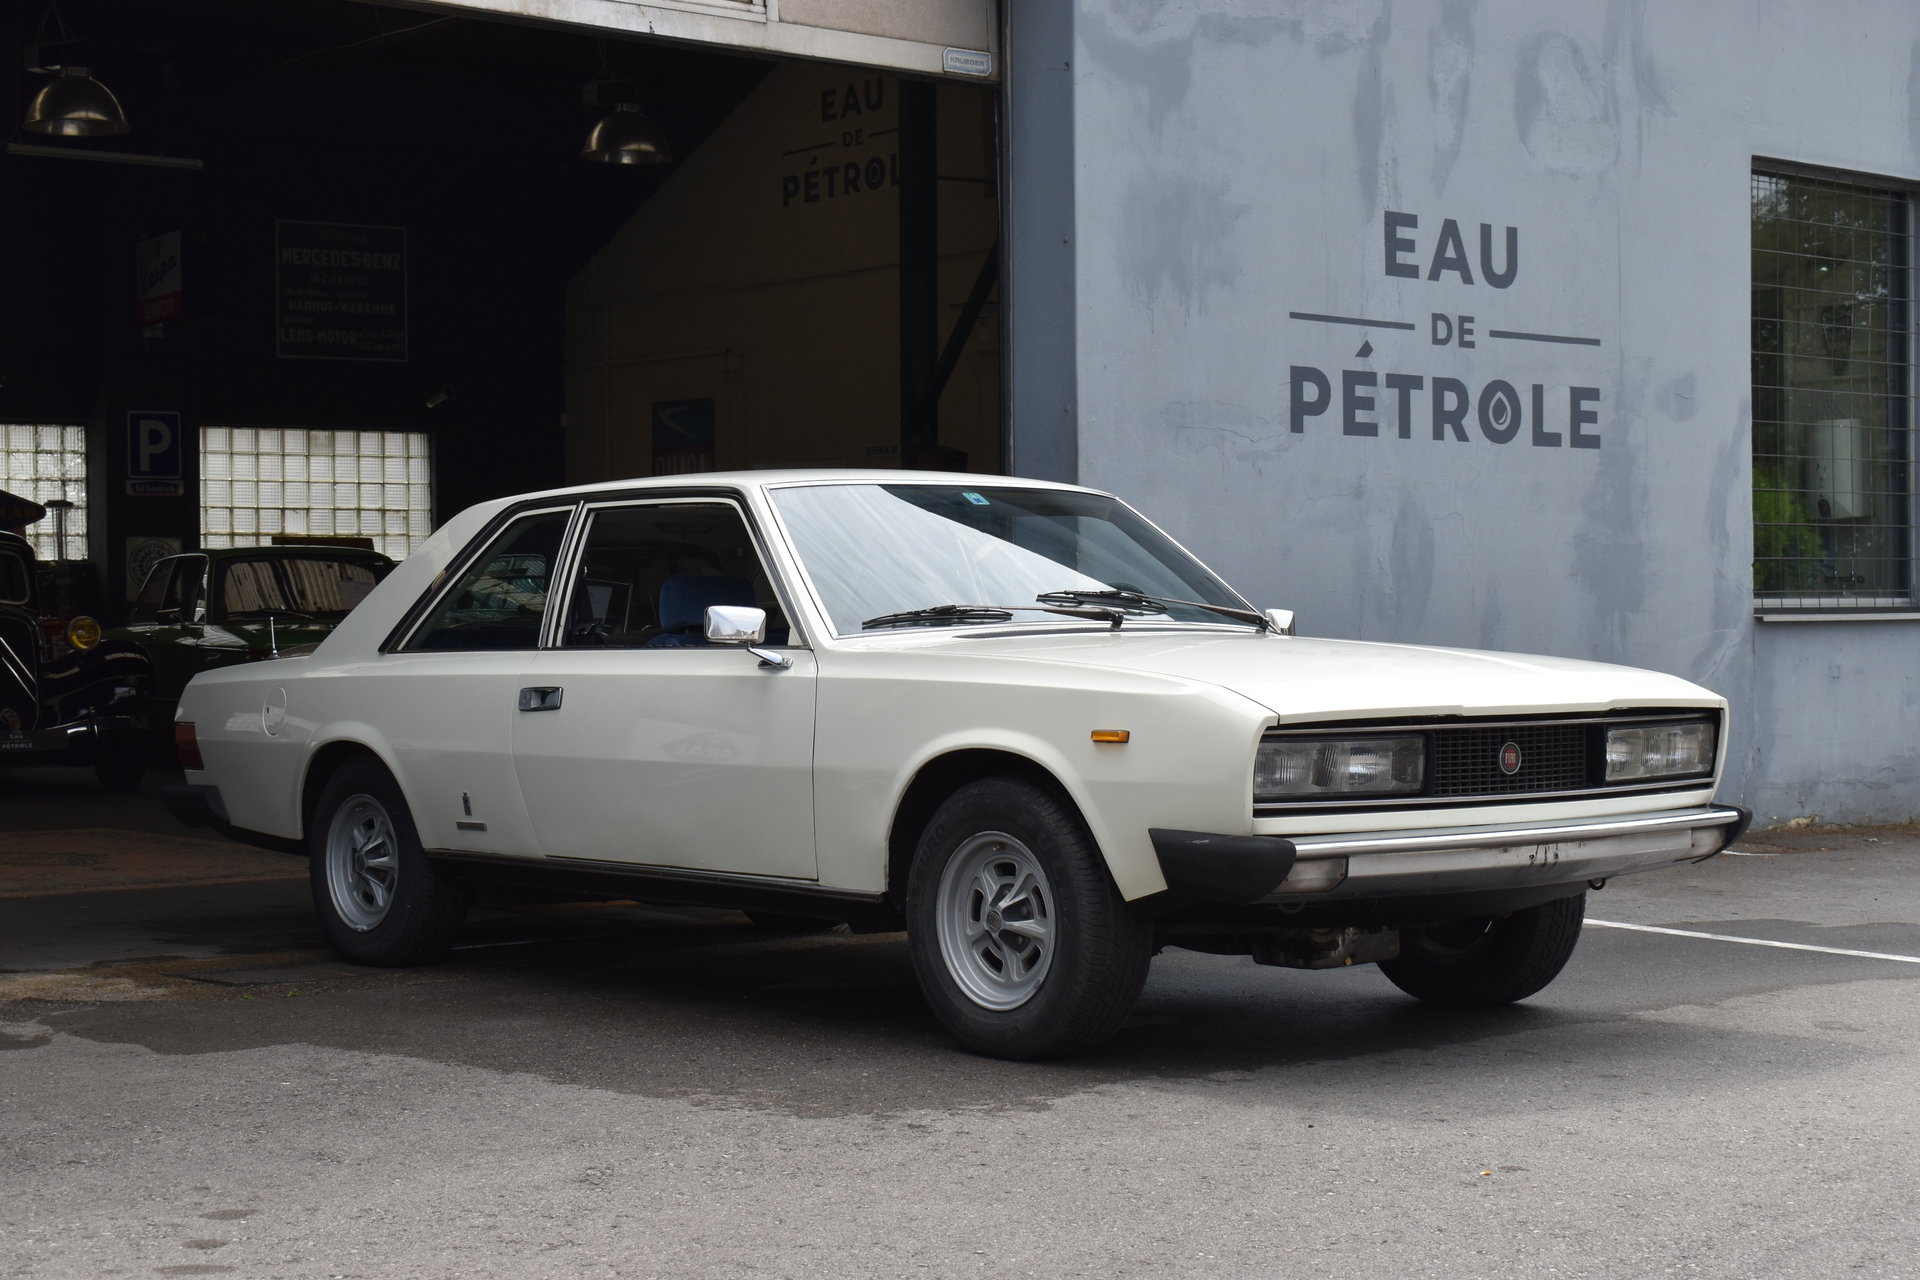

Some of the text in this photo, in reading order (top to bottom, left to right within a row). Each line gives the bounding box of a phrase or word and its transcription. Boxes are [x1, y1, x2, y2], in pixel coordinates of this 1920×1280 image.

[821, 77, 883, 123] EAU
[842, 128, 864, 148] DE
[782, 153, 901, 208] PÉTROL
[1384, 210, 1518, 289] EAU
[1431, 312, 1476, 349] DE
[1289, 339, 1601, 450] PÉTROLE
[140, 419, 172, 472] P
